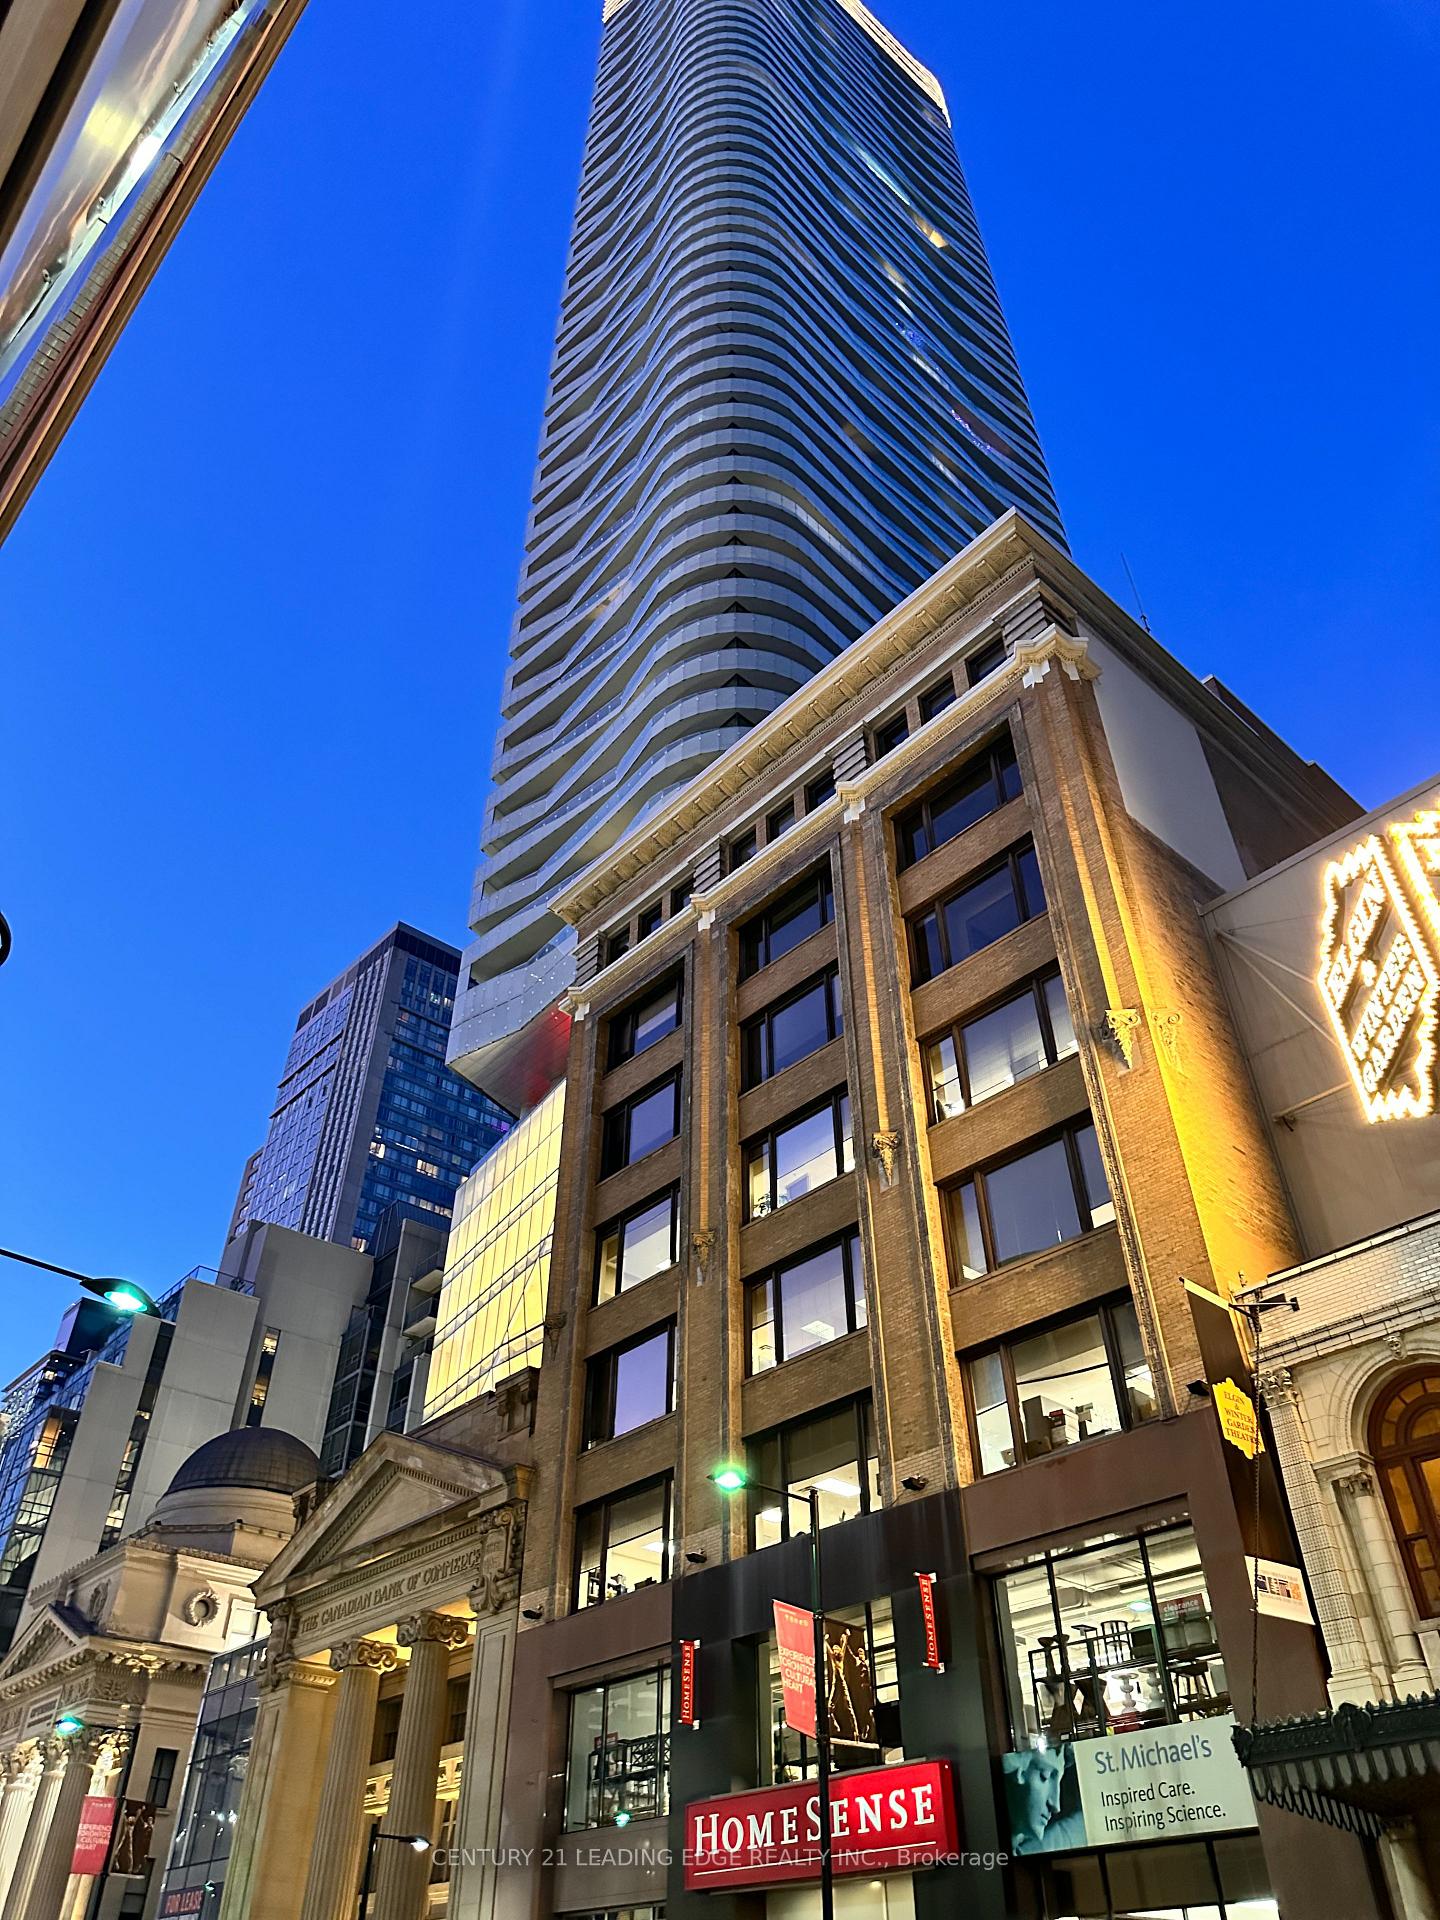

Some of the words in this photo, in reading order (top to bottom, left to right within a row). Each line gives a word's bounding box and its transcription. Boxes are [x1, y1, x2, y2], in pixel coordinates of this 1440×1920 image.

[1351, 932, 1412, 1061] WINTER
[1362, 959, 1428, 1093] GARDEN
[1224, 1407, 1254, 1425] WINTER
[1226, 1418, 1255, 1434] GARDEN
[300, 1611, 318, 1634] THE
[321, 1591, 372, 1626] CANADIAN
[373, 1578, 404, 1606] BANK
[406, 1572, 423, 1592] OF
[423, 1548, 481, 1586] COMMERCE
[1163, 1599, 1199, 1612] clearance
[922, 1578, 935, 1662] HOMESENSE
[778, 1646, 815, 1667] EXPERIENC
[682, 1645, 691, 1719] HOMESENSE
[782, 1678, 803, 1694] HEART
[785, 1668, 816, 1686] CULTURA
[1095, 1751, 1119, 1775] St.
[1122, 1735, 1212, 1770] Michael's
[1100, 1783, 1155, 1808] Inspired
[1158, 1780, 1196, 1800] Care.
[694, 1783, 935, 1857] HOMESENSE
[1104, 1809, 1165, 1833] Inspiring
[1166, 1803, 1227, 1825] Science.
[165, 1893, 181, 1914] FOR
[180, 1889, 204, 1912] LEASE
